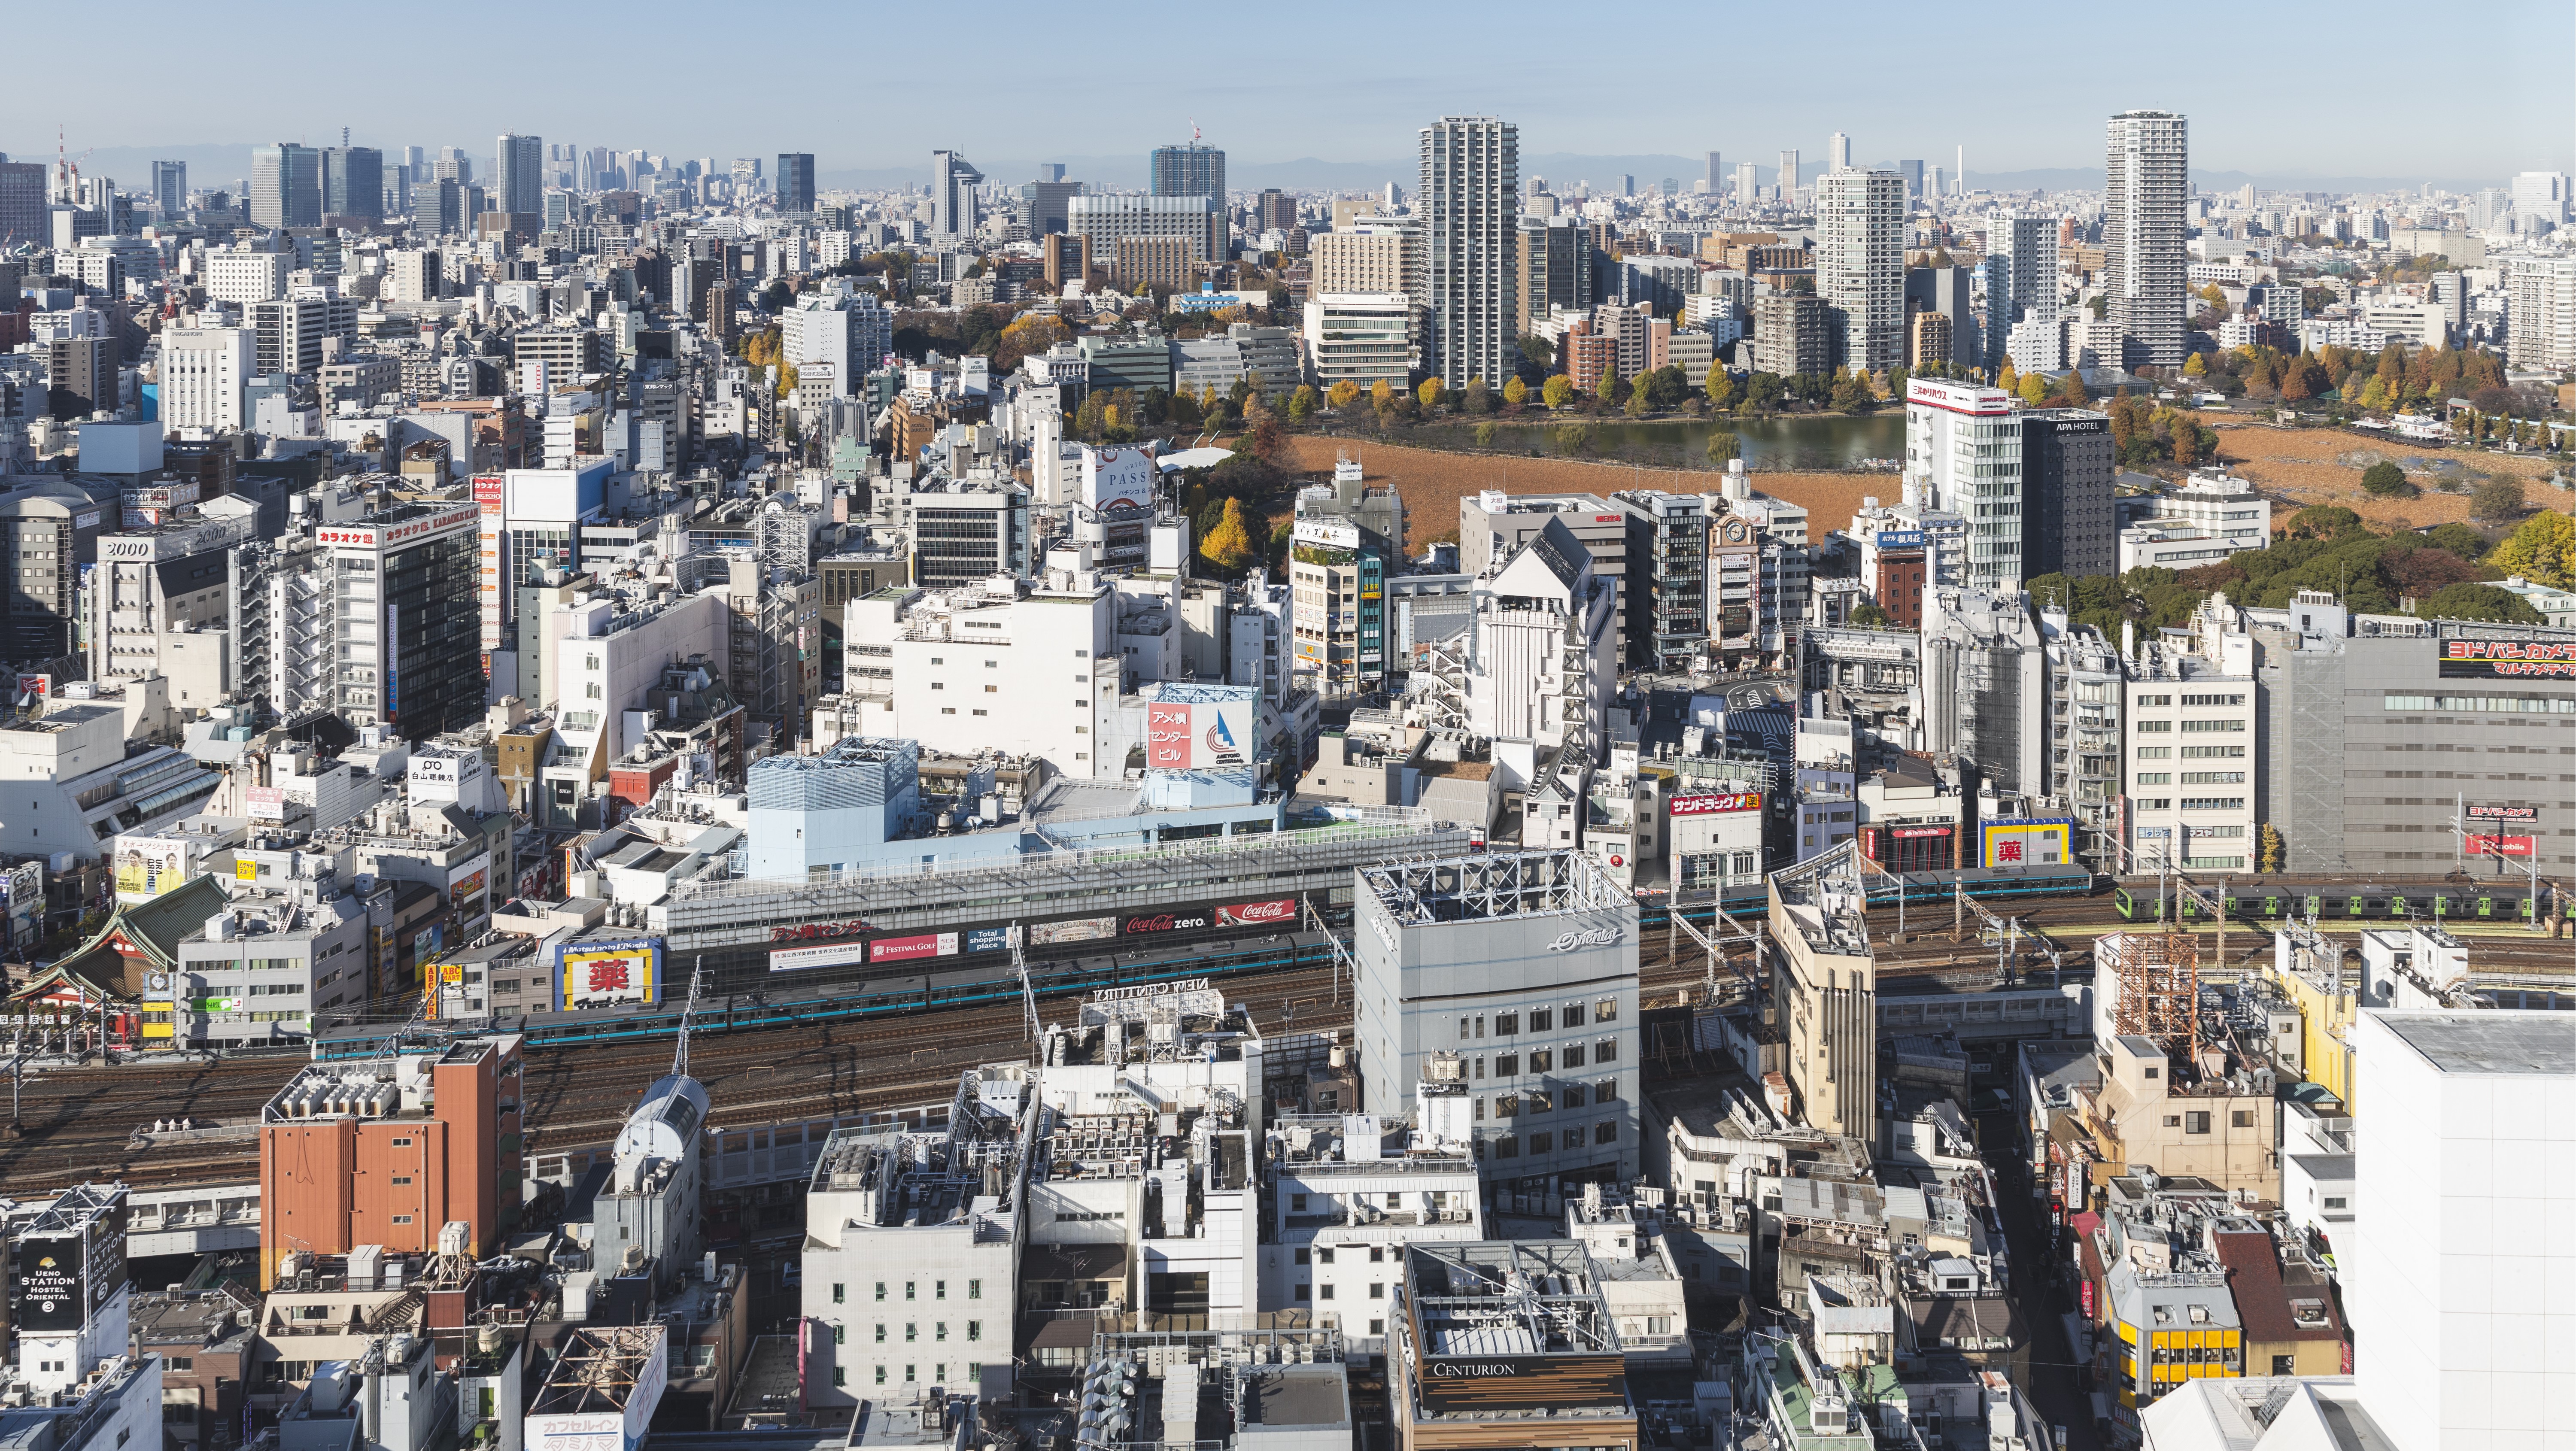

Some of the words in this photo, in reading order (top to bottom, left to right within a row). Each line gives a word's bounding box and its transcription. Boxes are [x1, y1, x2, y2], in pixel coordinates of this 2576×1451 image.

[1913, 385, 1947, 401] 三井のリハウス
[1125, 460, 1151, 471] ORIENT
[173, 487, 198, 500] カラオケ
[176, 502, 195, 516] パセラ
[433, 512, 464, 528] KARAOKE
[465, 508, 478, 520] KAN
[195, 526, 226, 546] 2000
[320, 532, 376, 544] カラオケ館
[387, 522, 425, 541] カラオケ館
[1897, 534, 1920, 544] 観月荘
[107, 542, 149, 556] 2000
[2448, 642, 2576, 660] ヨドバシカメラ
[1153, 712, 1187, 724] アメ横
[1149, 730, 1191, 743] センター
[1158, 749, 1182, 761] ビル
[412, 772, 454, 782] 白山眼鏡店
[459, 766, 481, 781] 白山眼鏡店
[1673, 797, 1734, 812] サンドラッグ
[1748, 797, 1758, 806] 薬
[2470, 807, 2533, 817] ヨドバシカメラ
[122, 841, 181, 850] スポーツジュエン
[1998, 841, 2022, 862] 薬
[1242, 902, 1285, 918] Coca-Cola
[770, 920, 874, 942] アメ横センター
[1127, 914, 1176, 933] Coca-Cola
[969, 936, 1006, 944] shopping
[1370, 916, 1395, 952] Oriental
[1547, 928, 1623, 951] Oriental
[782, 950, 817, 959] 国立西洋美術館
[818, 947, 858, 955] 世界文化遺産登録
[589, 959, 629, 992] 薬
[2035, 1132, 2044, 1147] 大山
[91, 1231, 114, 1254] UENO
[79, 1229, 126, 1281] STATION
[88, 1252, 118, 1281] HOSTEL
[21, 1277, 75, 1285] STATION
[637, 1342, 662, 1403] カプセルイン
[1434, 1363, 1515, 1376] CENTURION
[544, 1420, 618, 1433] カプセルイン
